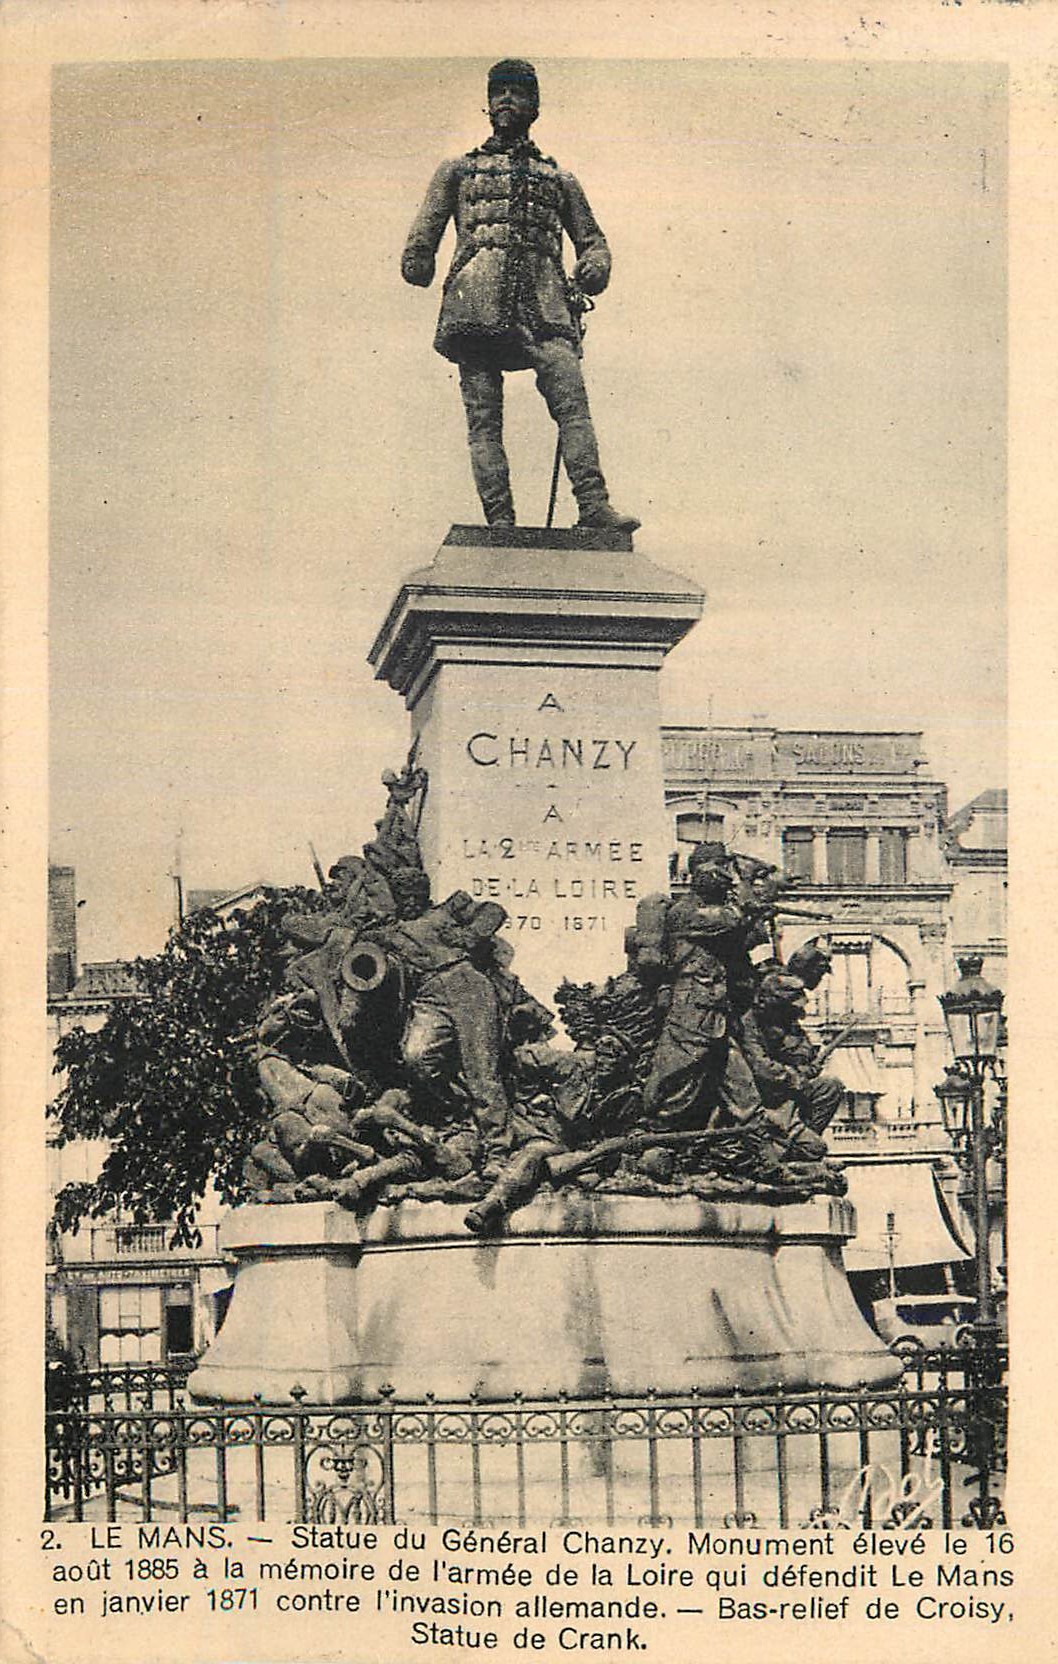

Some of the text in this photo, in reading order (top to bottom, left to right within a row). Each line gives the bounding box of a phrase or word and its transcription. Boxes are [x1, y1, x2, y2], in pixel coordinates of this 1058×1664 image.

[537, 692, 564, 712] A
[467, 732, 637, 770] CHANZY
[543, 804, 563, 823] A
[463, 839, 491, 859] LA
[472, 877, 501, 897] DE
[554, 878, 637, 899] LOIRE
[504, 915, 542, 931] 870
